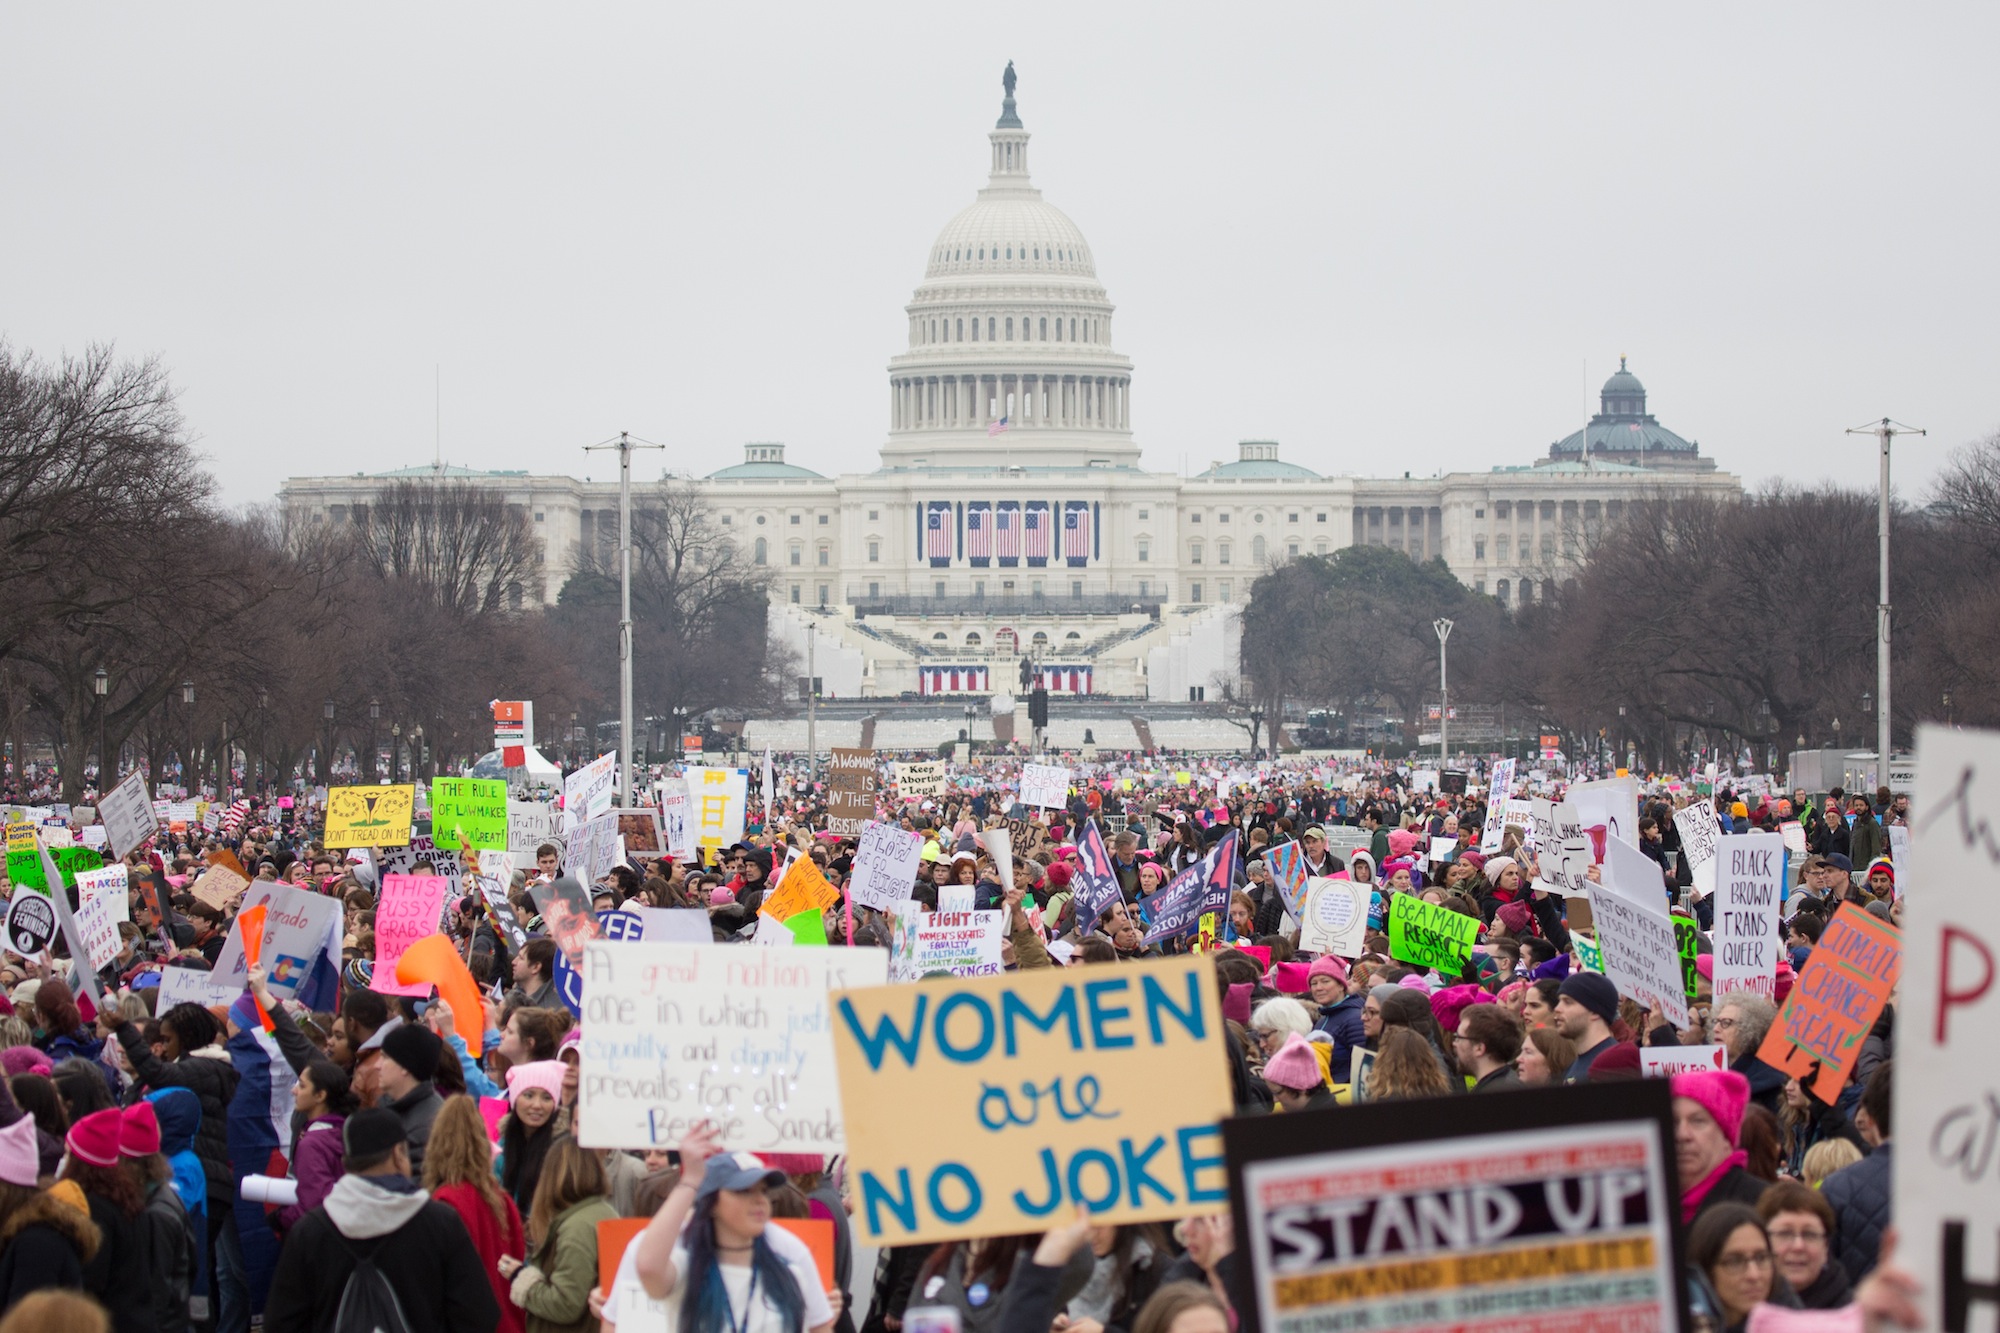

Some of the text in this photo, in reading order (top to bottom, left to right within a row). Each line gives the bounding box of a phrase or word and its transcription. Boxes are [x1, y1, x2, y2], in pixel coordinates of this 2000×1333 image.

[505, 707, 512, 717] 3
[831, 753, 839, 768] A
[909, 765, 935, 775] Keep
[900, 774, 944, 784] Abortion
[1026, 766, 1065, 778] STUDY
[440, 782, 498, 798] THE RULE
[862, 776, 874, 791] IS
[909, 785, 937, 795] Legal
[1025, 776, 1067, 789] SCIENCE
[829, 791, 872, 807] IN THE
[1022, 787, 1066, 805] NOT WAR
[438, 803, 452, 816] OF
[1506, 811, 1529, 823] HER
[133, 799, 154, 840] WITH
[511, 813, 544, 828] Truth
[550, 814, 564, 835] NO
[1487, 815, 1502, 832] ONE
[9, 832, 33, 841] RIGHTS
[351, 828, 379, 841] TREAD
[381, 828, 392, 840] ON
[395, 827, 410, 840] ME
[511, 830, 548, 848] Matters
[863, 821, 888, 838] WHEN
[9, 842, 34, 850] HUMAN
[861, 832, 912, 862] GO LOW
[1011, 842, 1030, 858] ME
[1542, 839, 1562, 856] NOT
[437, 862, 460, 877] FOR
[857, 854, 886, 871] WE GO
[1731, 849, 1773, 878] BLACK
[204, 884, 222, 896] OK
[387, 879, 437, 897] THIS
[786, 865, 809, 898] LIKE
[868, 870, 910, 901] HIGH
[1731, 881, 1774, 907] BROWN
[79, 897, 102, 922] THIS
[379, 900, 435, 919] PUSSY
[13, 912, 50, 938] FEMINISM
[378, 919, 431, 938] GRABS
[928, 911, 992, 928] FIGHT FOR
[1414, 904, 1427, 927] A
[1430, 908, 1469, 941] MAN
[1593, 890, 1676, 950] HISTORY REPEATS
[1724, 911, 1768, 938] TRANS
[918, 928, 986, 941] WOMEN'S RIGHTS
[1403, 922, 1469, 960] RESPECT
[1405, 943, 1465, 971] WOMEN
[1642, 933, 1673, 965] FIRST
[1722, 940, 1764, 968] QUEER
[1818, 918, 1903, 984] CLIMATE
[953, 956, 984, 966] CHANGE
[1603, 950, 1644, 981] SECOND
[1645, 974, 1656, 987] AS
[586, 948, 614, 983] A
[641, 950, 700, 996] great
[727, 950, 811, 989] nation
[825, 959, 848, 989] is
[1716, 974, 1776, 997] LIVES MATTER
[1801, 961, 1877, 1025] CHANGE
[586, 993, 769, 1029] one in which
[1662, 997, 1685, 1022] MARX
[836, 971, 1207, 1073] WOMEN
[1785, 1003, 1845, 1064] REAL
[584, 1027, 808, 1078] equality and dignity
[585, 1068, 681, 1107] prevails
[696, 1071, 744, 1108] for
[976, 1074, 1122, 1132] are
[859, 1160, 983, 1238] NO
[1011, 1123, 1230, 1217] JOKE
[1266, 1184, 1523, 1274] STAND
[1543, 1166, 1648, 1238] UP
